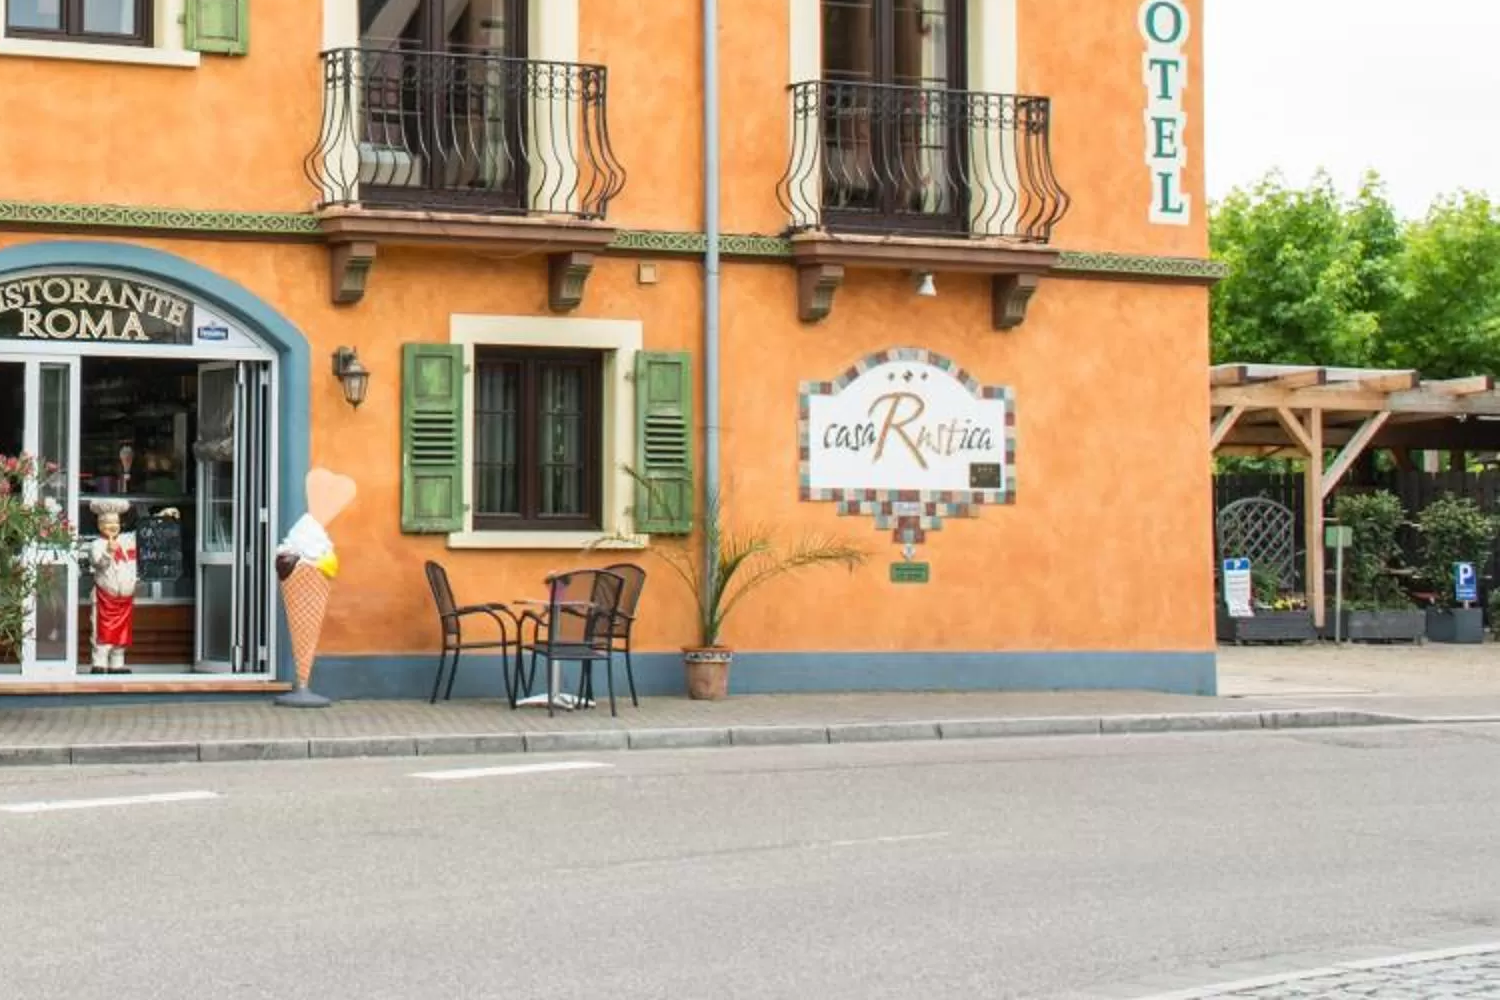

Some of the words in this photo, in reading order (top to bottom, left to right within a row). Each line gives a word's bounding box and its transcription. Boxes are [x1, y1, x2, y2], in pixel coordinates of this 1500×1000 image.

[18, 307, 150, 341] ROMA
[823, 422, 877, 451] casa
[868, 391, 994, 471] Rustica
[1460, 564, 1472, 585] P
